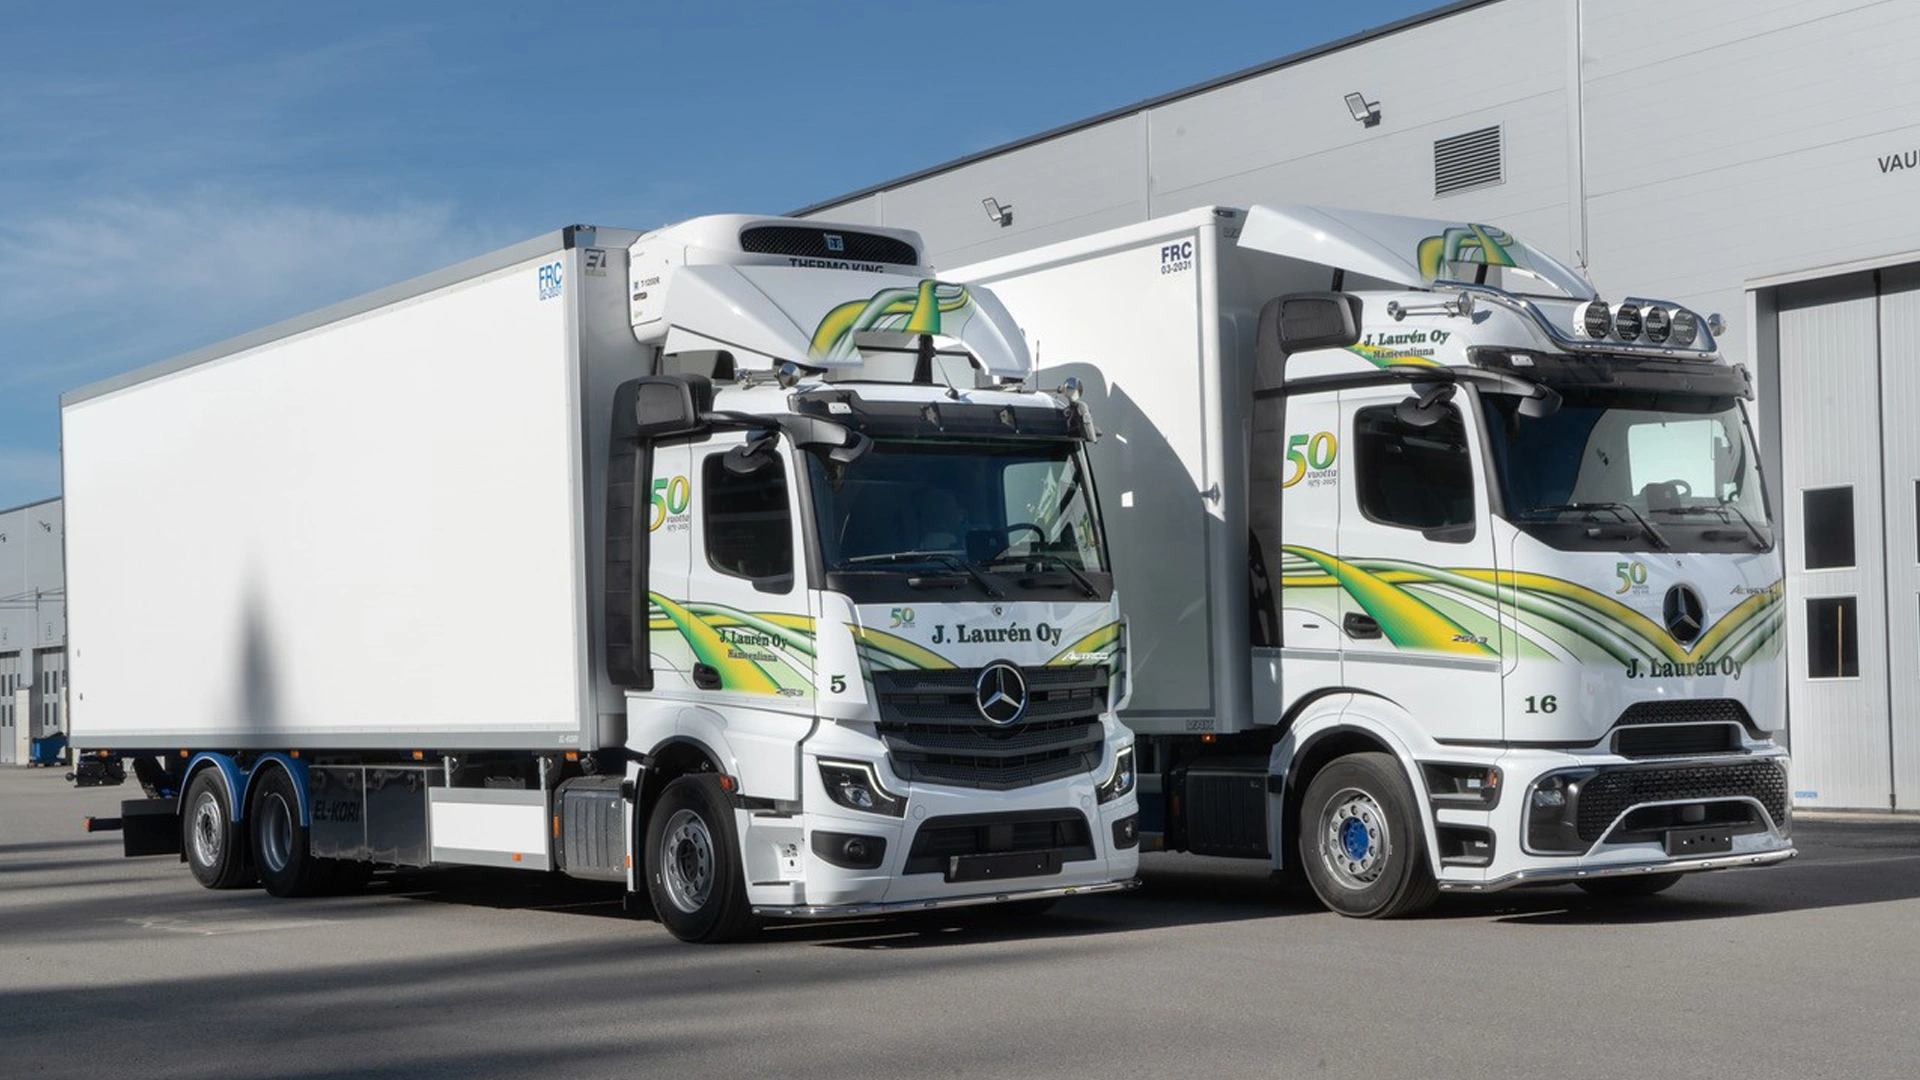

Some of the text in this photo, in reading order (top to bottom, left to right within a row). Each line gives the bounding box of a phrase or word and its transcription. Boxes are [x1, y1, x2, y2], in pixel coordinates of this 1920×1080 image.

[1878, 149, 1920, 173] VAU
[1161, 241, 1192, 263] FRC
[539, 262, 563, 290] FRC
[1161, 261, 1191, 275] 03-2031
[1363, 329, 1451, 347] J. Laurén Oy
[1281, 431, 1337, 488] 50
[650, 475, 690, 532] 50
[1615, 561, 1647, 594] 50
[889, 607, 915, 629] 50
[720, 630, 788, 650] J. Laurén Oy
[931, 622, 1063, 646] J. Laurén Oy
[1626, 653, 1744, 680] J. Laurén Oy
[830, 674, 847, 694] 5
[1525, 695, 1557, 713] 16
[314, 800, 361, 822] EL-KORI
